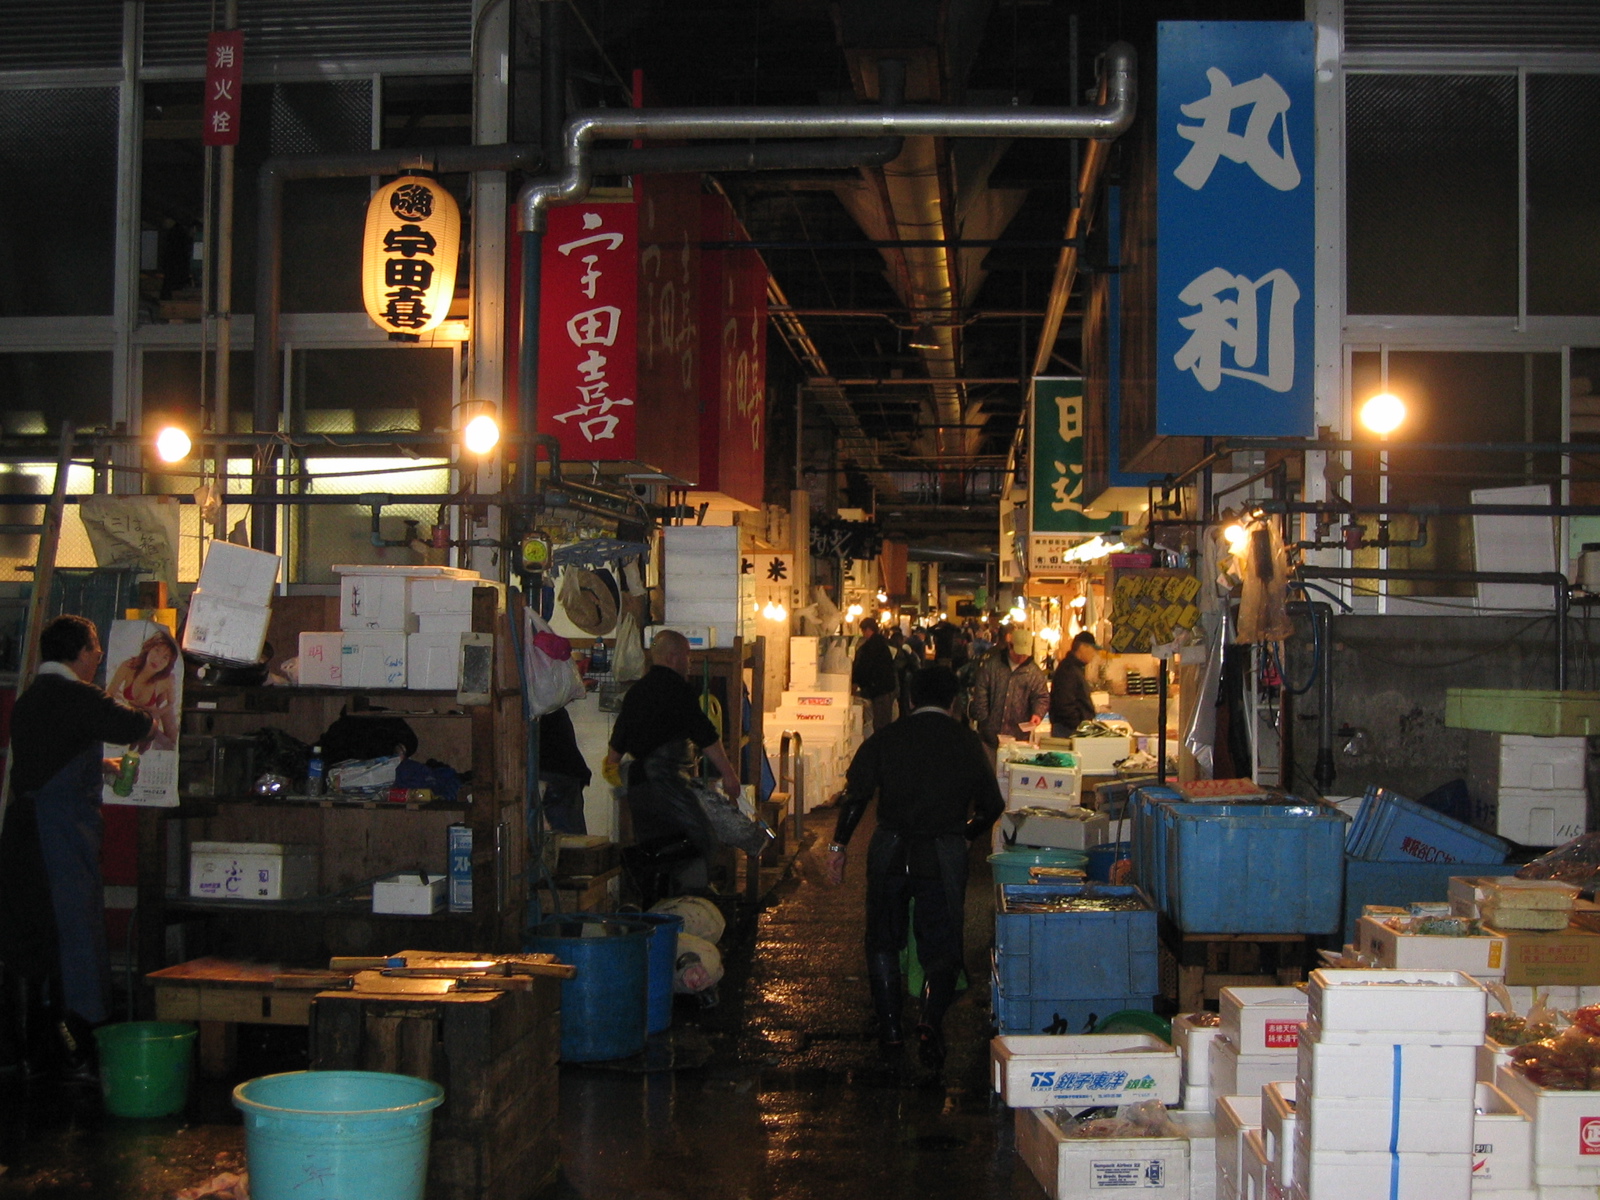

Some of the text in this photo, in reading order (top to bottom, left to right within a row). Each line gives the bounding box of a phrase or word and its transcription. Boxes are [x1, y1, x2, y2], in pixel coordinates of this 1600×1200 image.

[212, 45, 234, 134] 消火栓
[379, 224, 437, 329] 宇田喜
[1172, 66, 1302, 394] 丸利
[552, 212, 634, 444] 宇田喜
[1053, 1070, 1129, 1091] 銚子東洋
